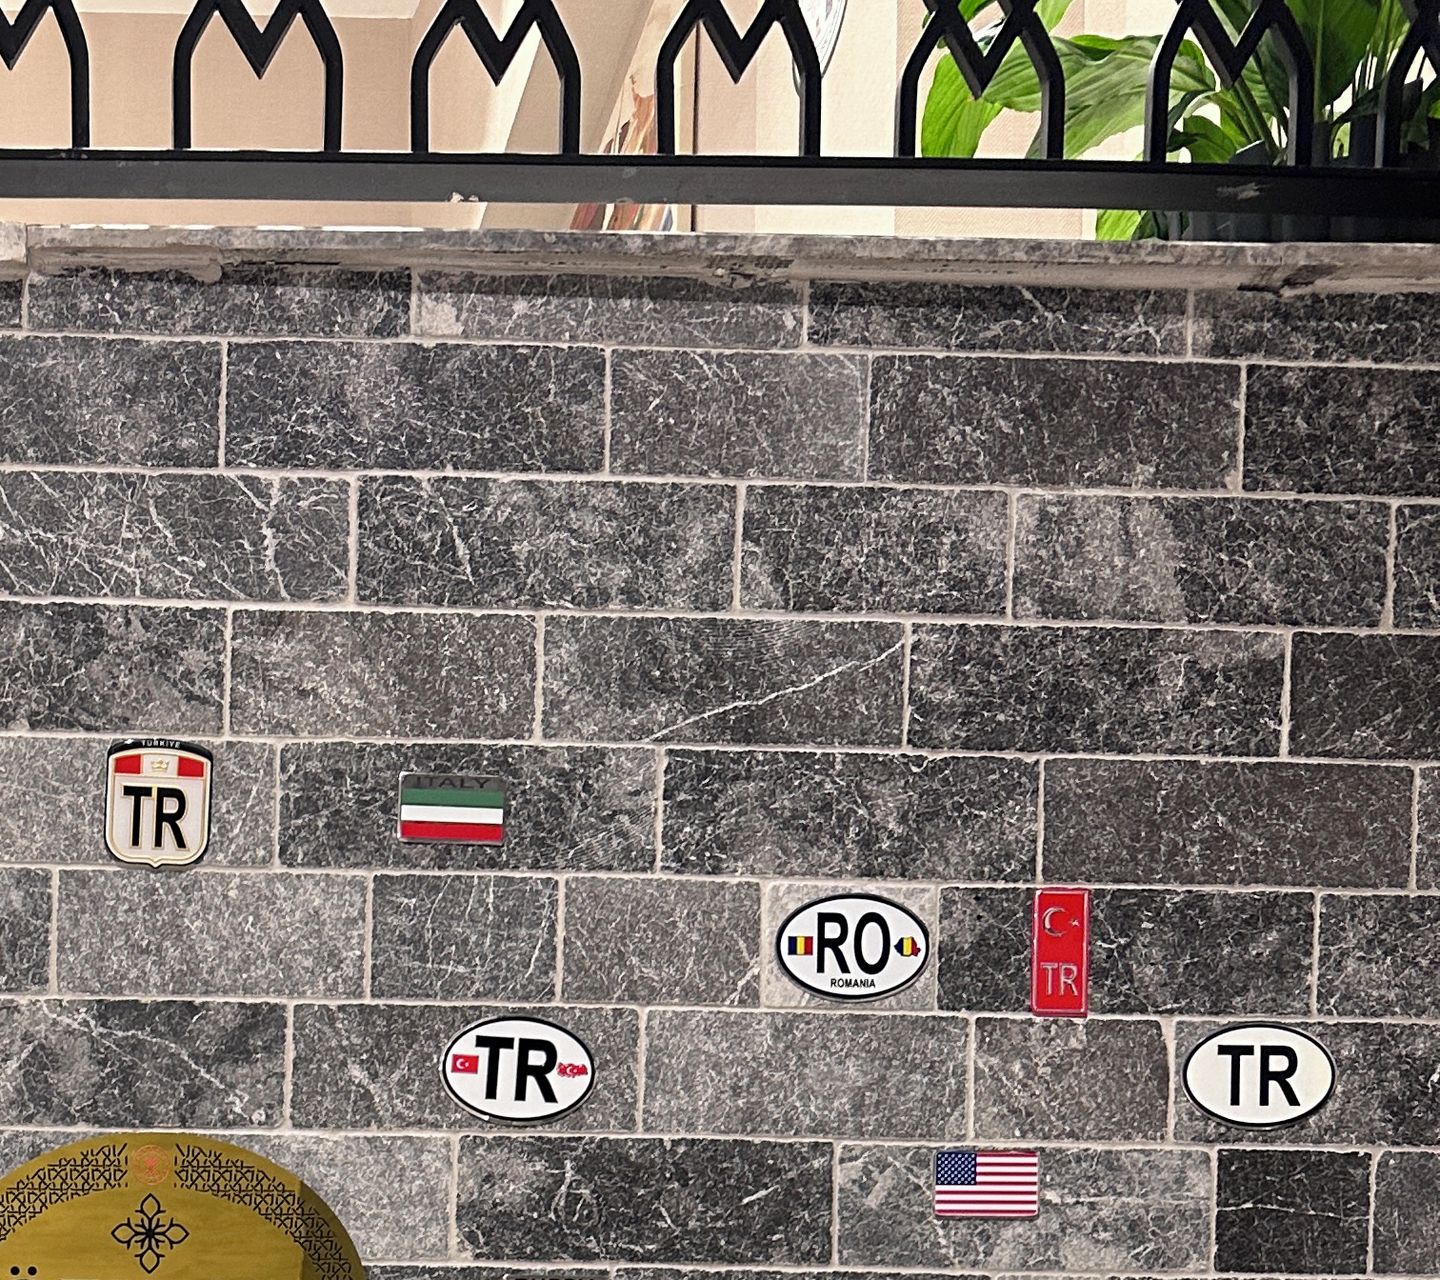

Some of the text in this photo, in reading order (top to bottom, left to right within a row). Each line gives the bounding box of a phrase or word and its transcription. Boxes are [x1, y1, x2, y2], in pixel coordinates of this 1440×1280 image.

[416, 776, 490, 789] ITALY
[123, 785, 187, 849] TR
[816, 911, 891, 975] RO
[830, 978, 877, 989] ROMANIA
[1040, 961, 1079, 996] TR
[475, 1035, 559, 1104] TR
[1217, 1044, 1301, 1107] TR
